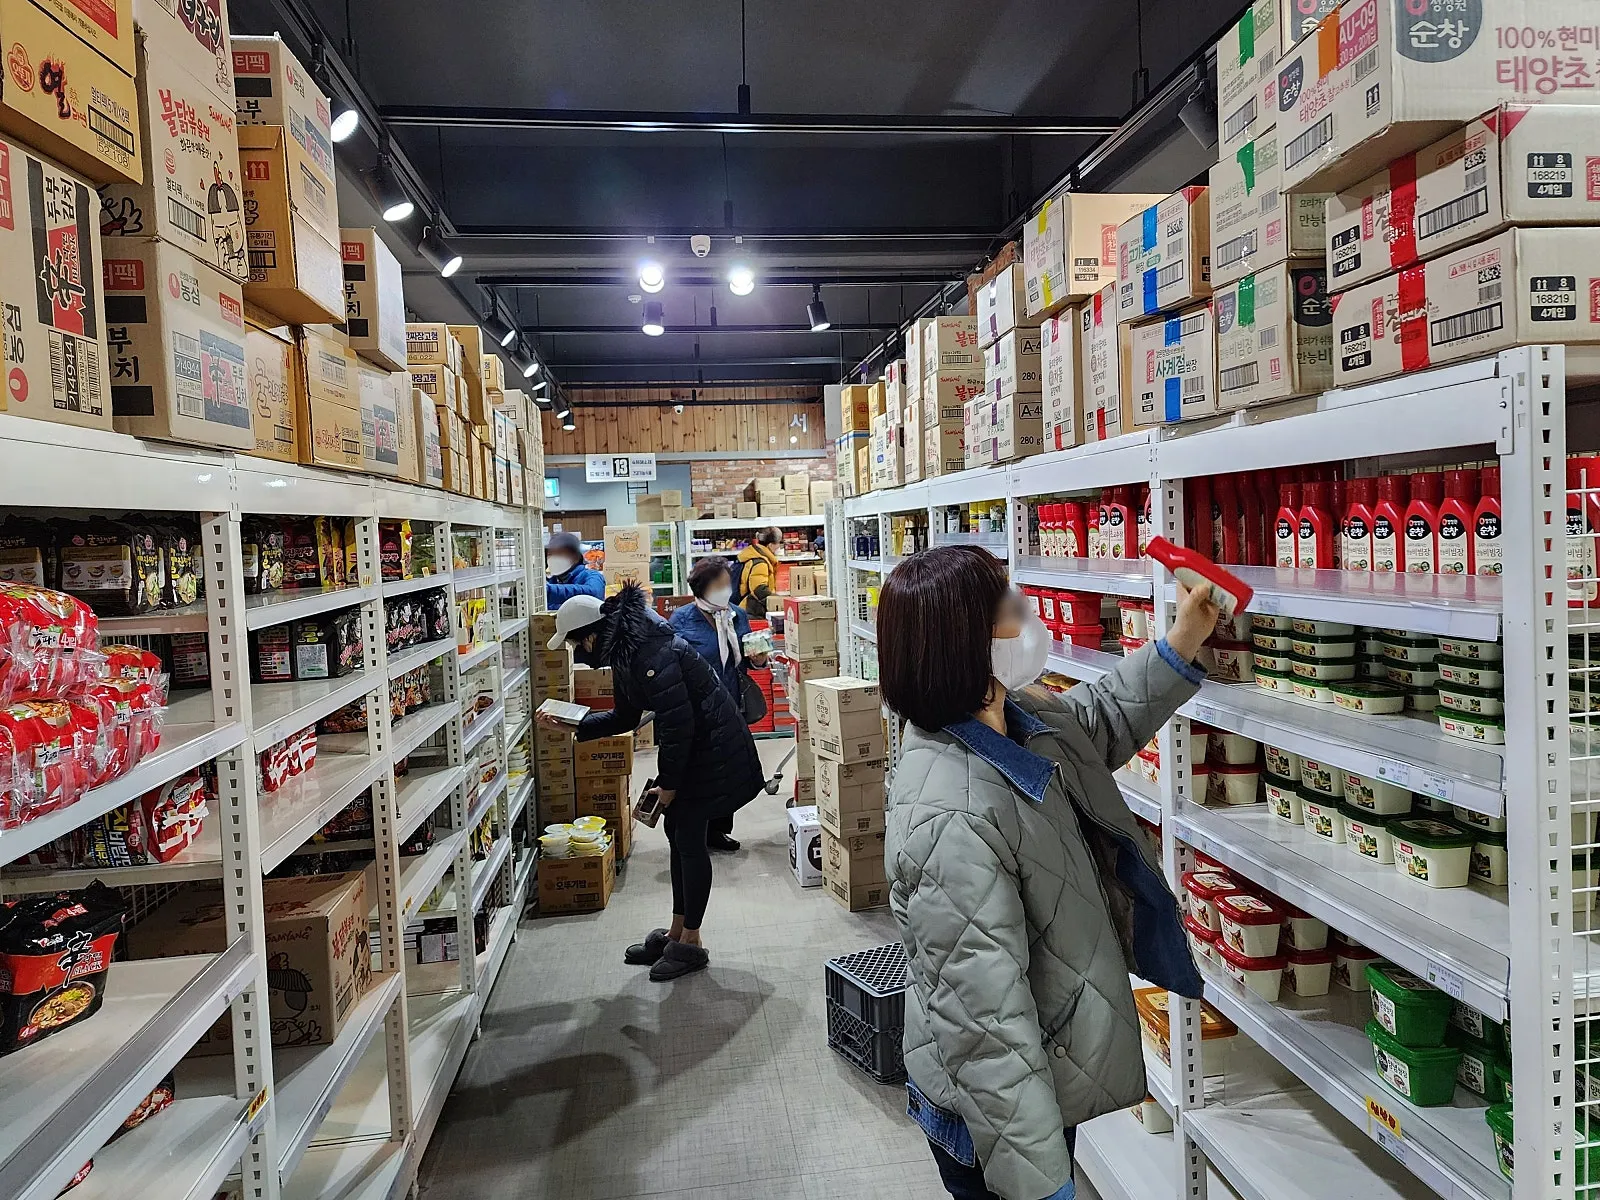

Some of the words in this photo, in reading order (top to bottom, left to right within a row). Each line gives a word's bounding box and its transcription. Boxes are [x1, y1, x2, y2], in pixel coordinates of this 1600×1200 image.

[1339, 1, 1376, 45] AU-09
[1408, 18, 1470, 50] 순창
[1495, 55, 1596, 95] 태양초
[1282, 79, 1301, 105] 순창
[158, 88, 211, 143] 불닭볶음면
[1299, 92, 1328, 123] 태양초
[1555, 154, 1564, 164] 8
[1532, 169, 1566, 181] 168219
[1537, 184, 1563, 196] 4개입
[1335, 243, 1357, 260] 168219
[39, 248, 86, 311] 辛
[1560, 278, 1567, 287] 8
[180, 280, 201, 307] 농심
[1536, 294, 1570, 304] 168219
[1540, 307, 1567, 319] 4개입
[1344, 340, 1367, 355] 168219
[1155, 353, 1186, 378] 사계절
[1022, 372, 1037, 381] 280
[1019, 436, 1034, 445] 280
[613, 458, 628, 475] 13
[57, 930, 93, 989] 辛
